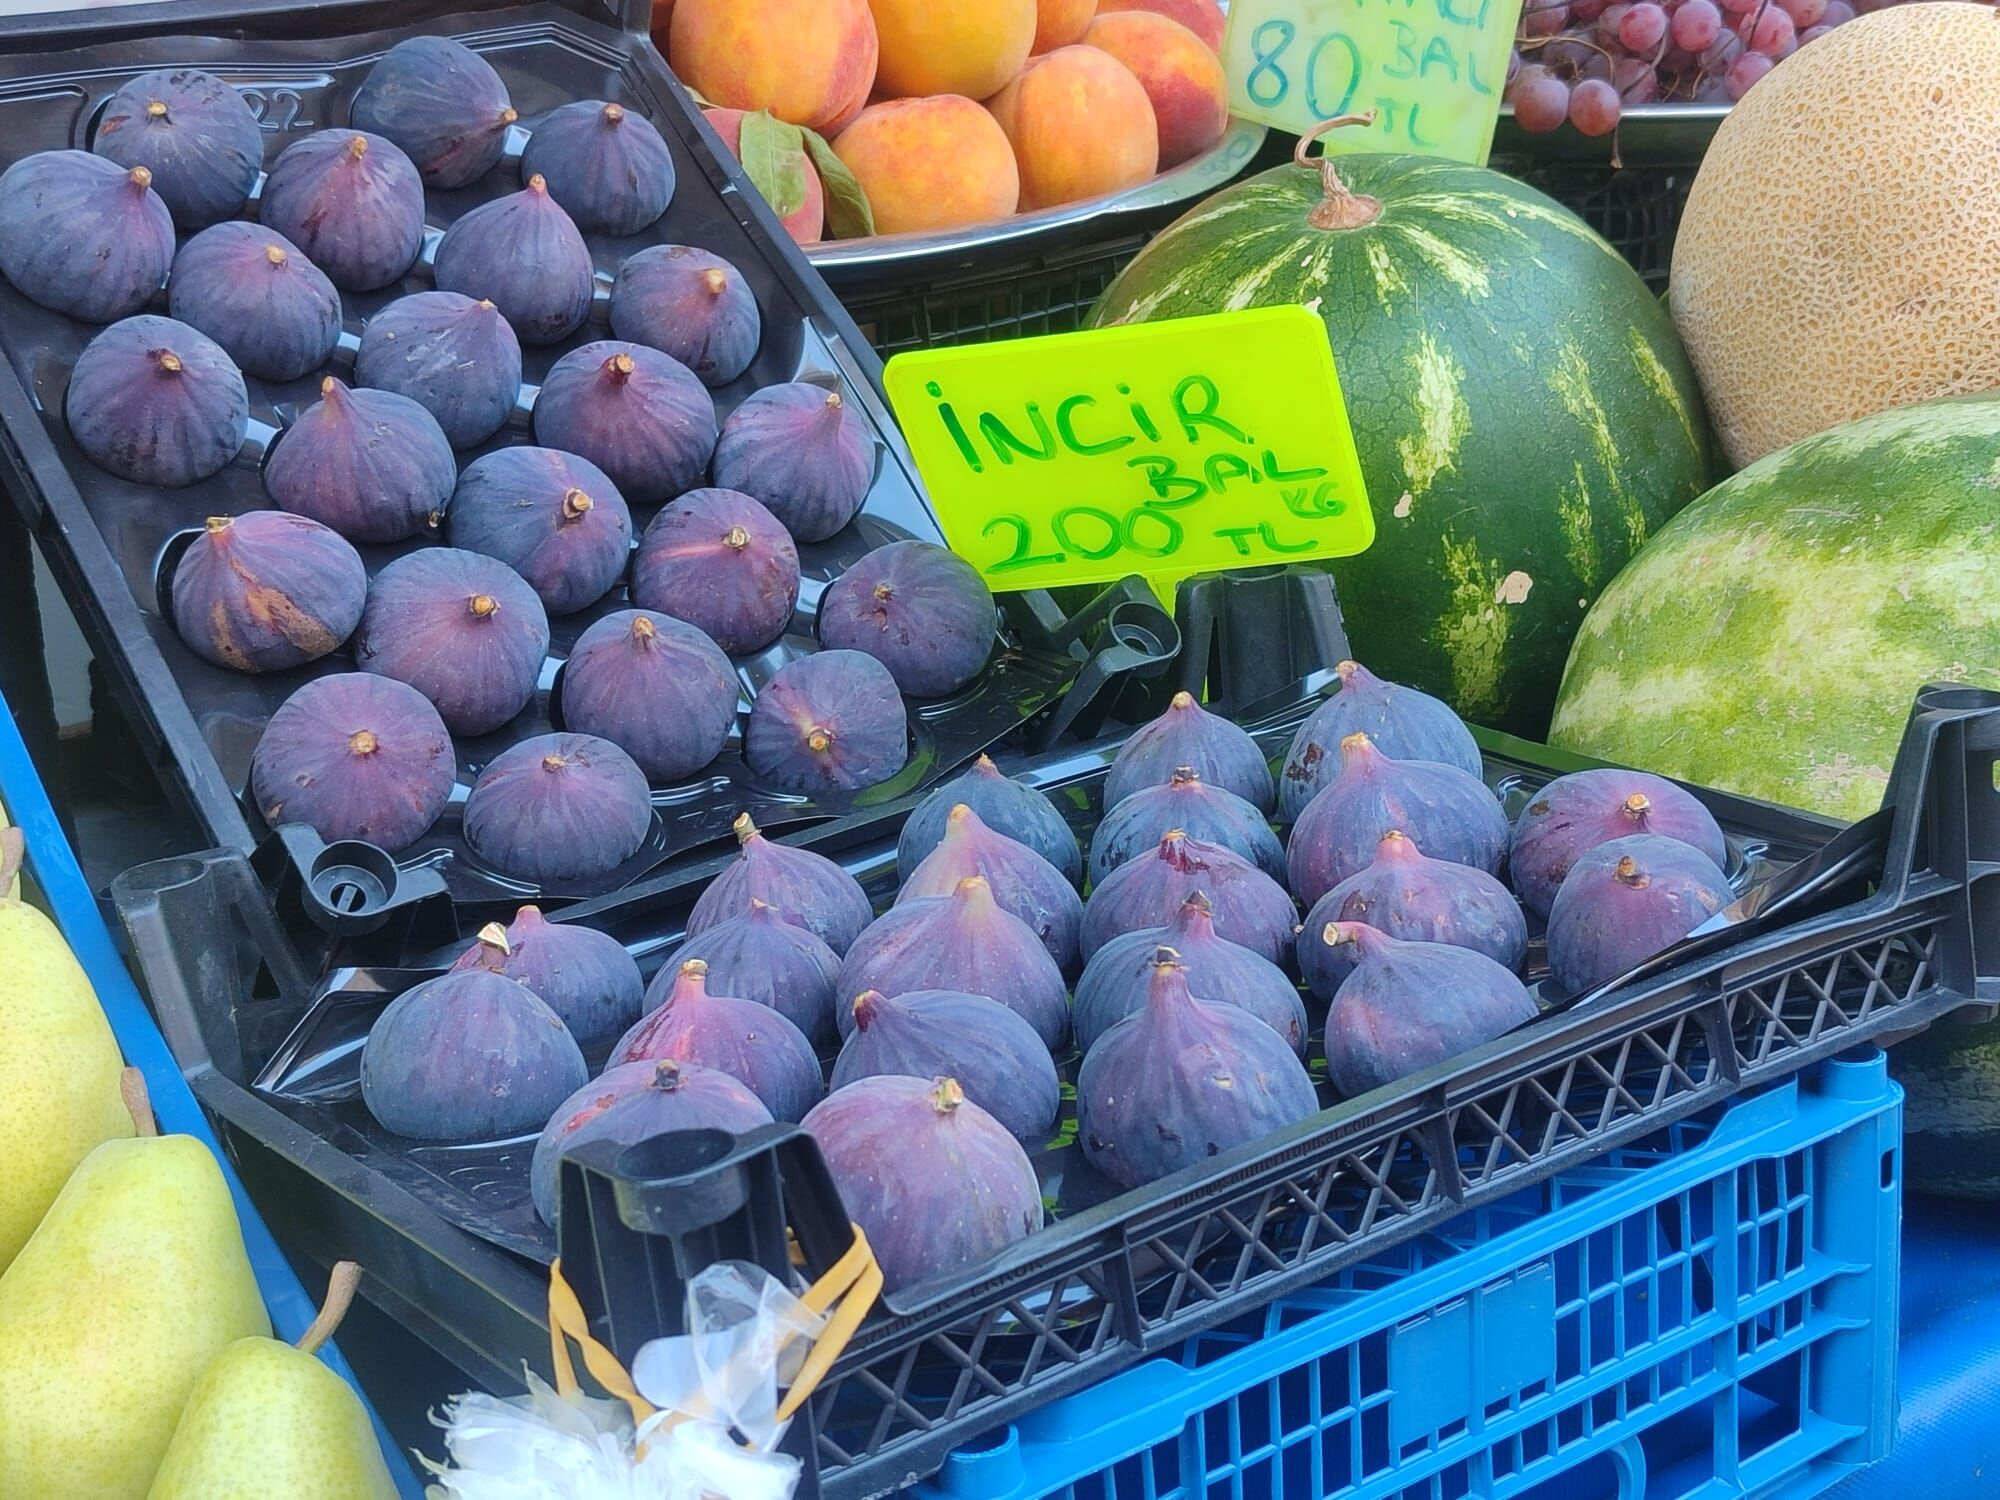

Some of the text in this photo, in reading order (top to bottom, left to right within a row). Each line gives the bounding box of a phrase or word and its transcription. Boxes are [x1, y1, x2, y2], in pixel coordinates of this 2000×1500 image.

[1246, 19, 1439, 148] 80 TL
[1383, 19, 1492, 95] BAL
[1127, 449, 1329, 509] BAL
[982, 505, 1319, 574] 200 TL
